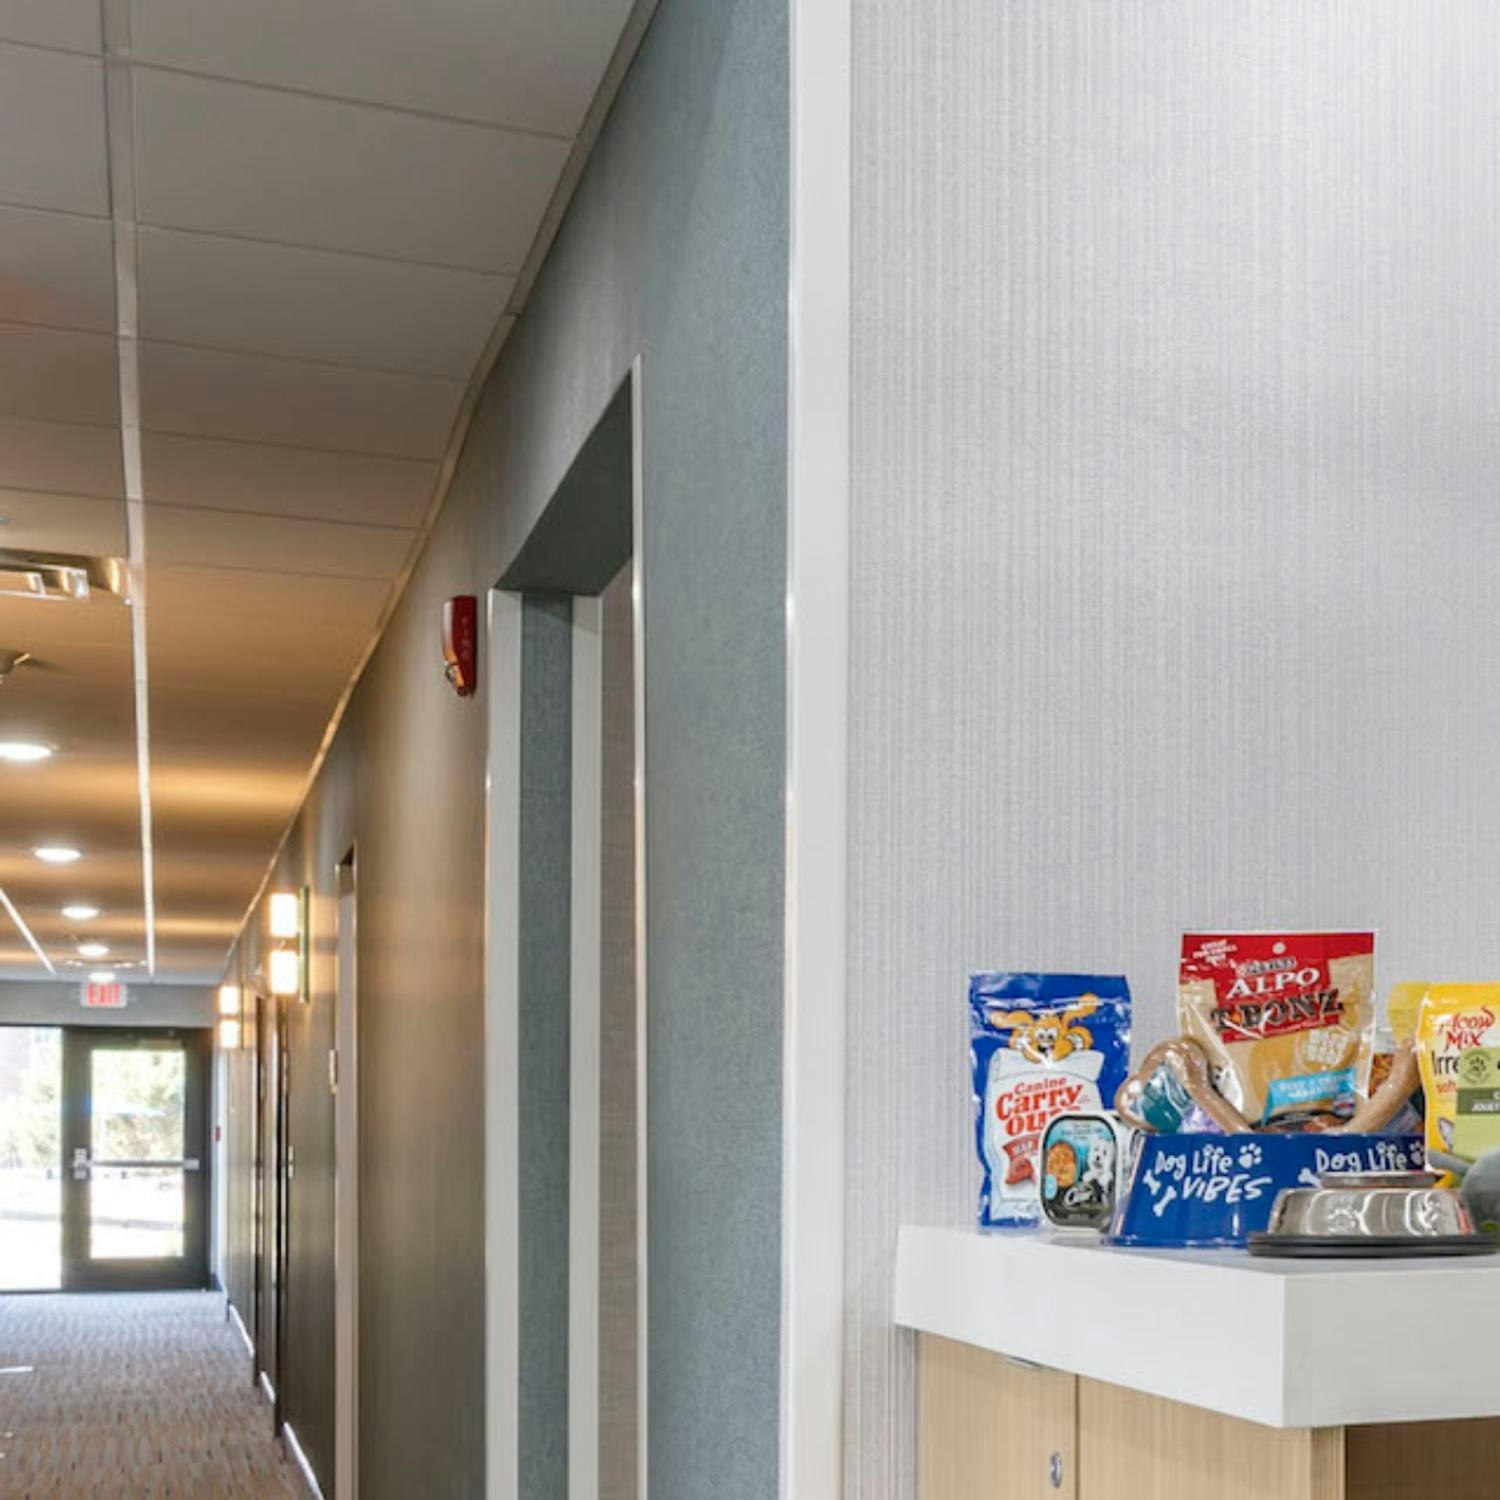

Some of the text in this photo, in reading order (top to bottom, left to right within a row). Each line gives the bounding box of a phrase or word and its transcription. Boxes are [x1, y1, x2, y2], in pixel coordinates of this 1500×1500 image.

[1227, 967, 1320, 1000] ALPO
[996, 1085, 1082, 1120] Carry
[1014, 1078, 1066, 1095] Canine
[1155, 1144, 1233, 1181] Dog Life
[1316, 1142, 1407, 1173] Dog Life
[1183, 1175, 1272, 1203] VIBES
